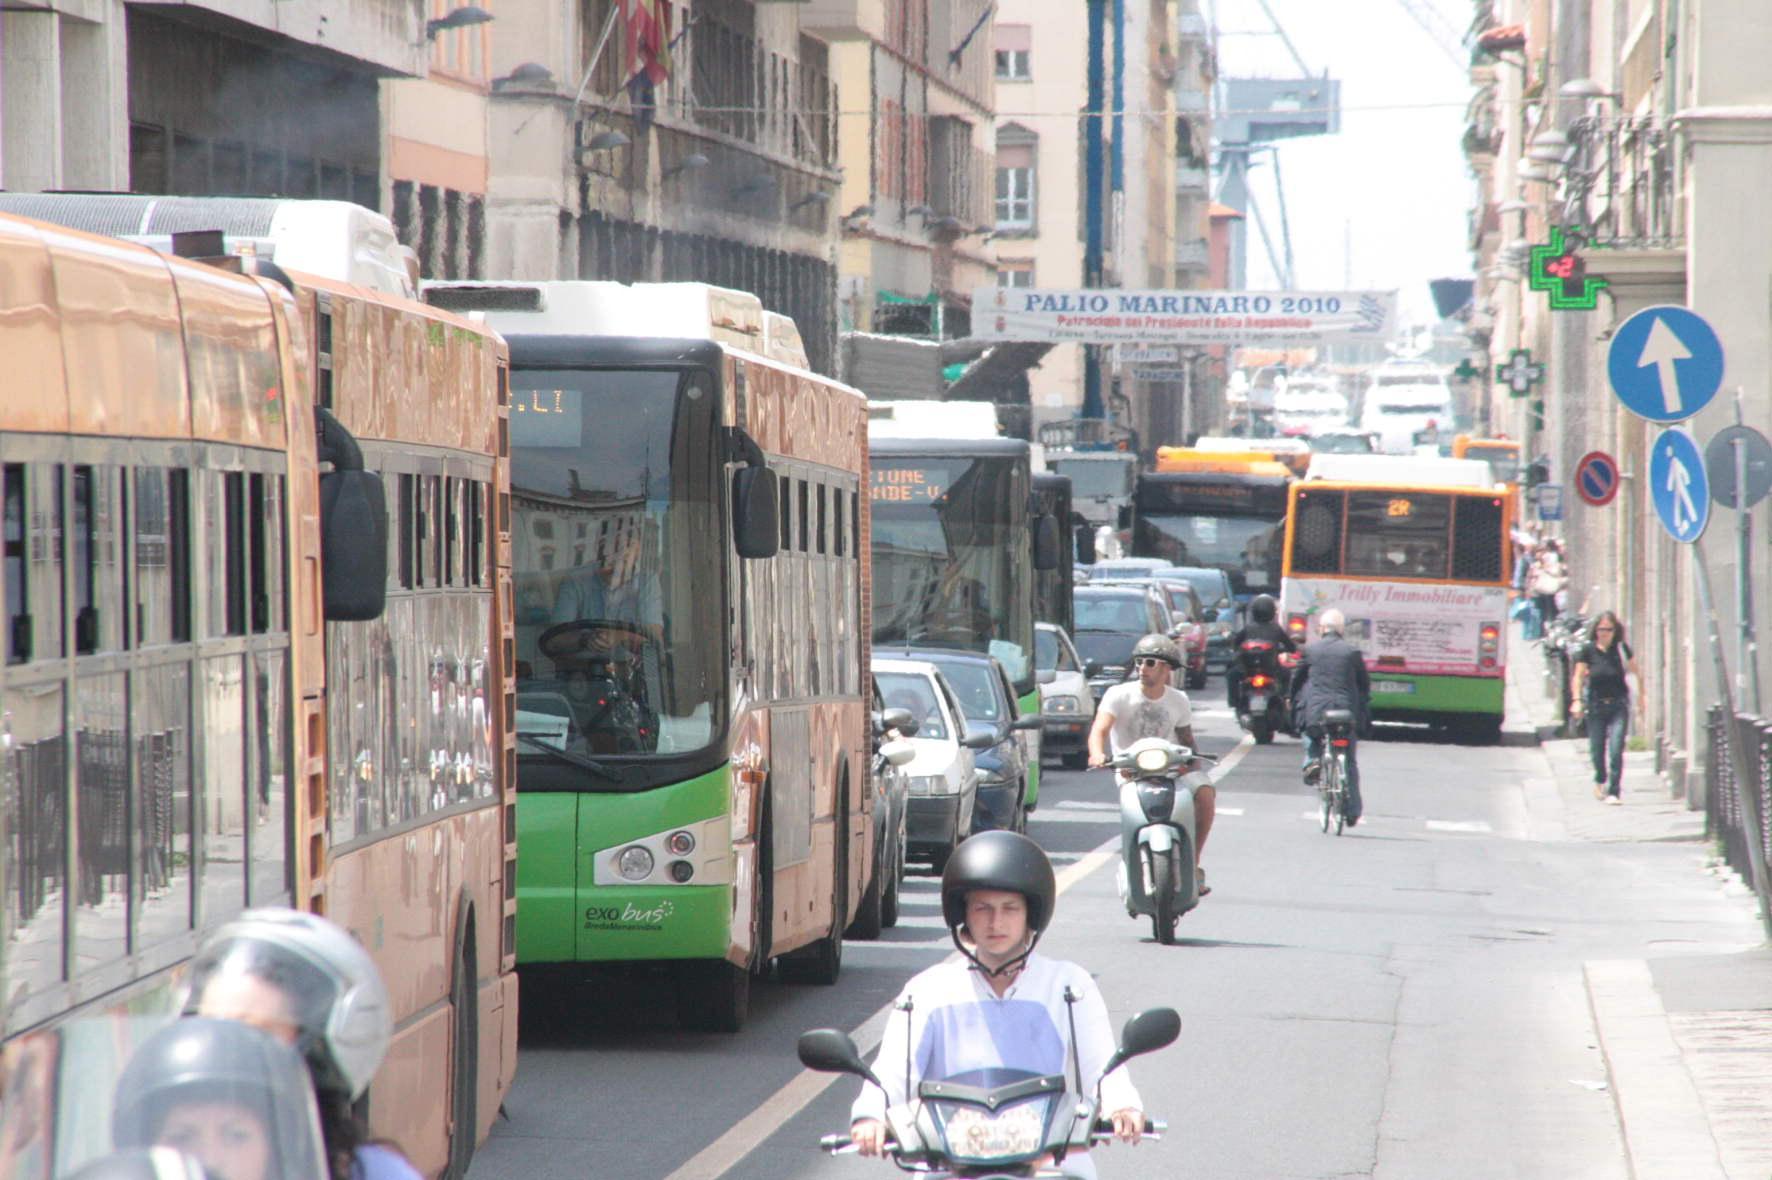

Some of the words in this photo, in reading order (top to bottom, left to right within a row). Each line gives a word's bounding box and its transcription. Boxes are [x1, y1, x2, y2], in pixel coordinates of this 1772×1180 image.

[1025, 294, 1108, 313] PALIO
[1119, 295, 1271, 314] MARINARO
[1282, 297, 1341, 314] 2010
[1384, 585, 1483, 607] Immobiliare
